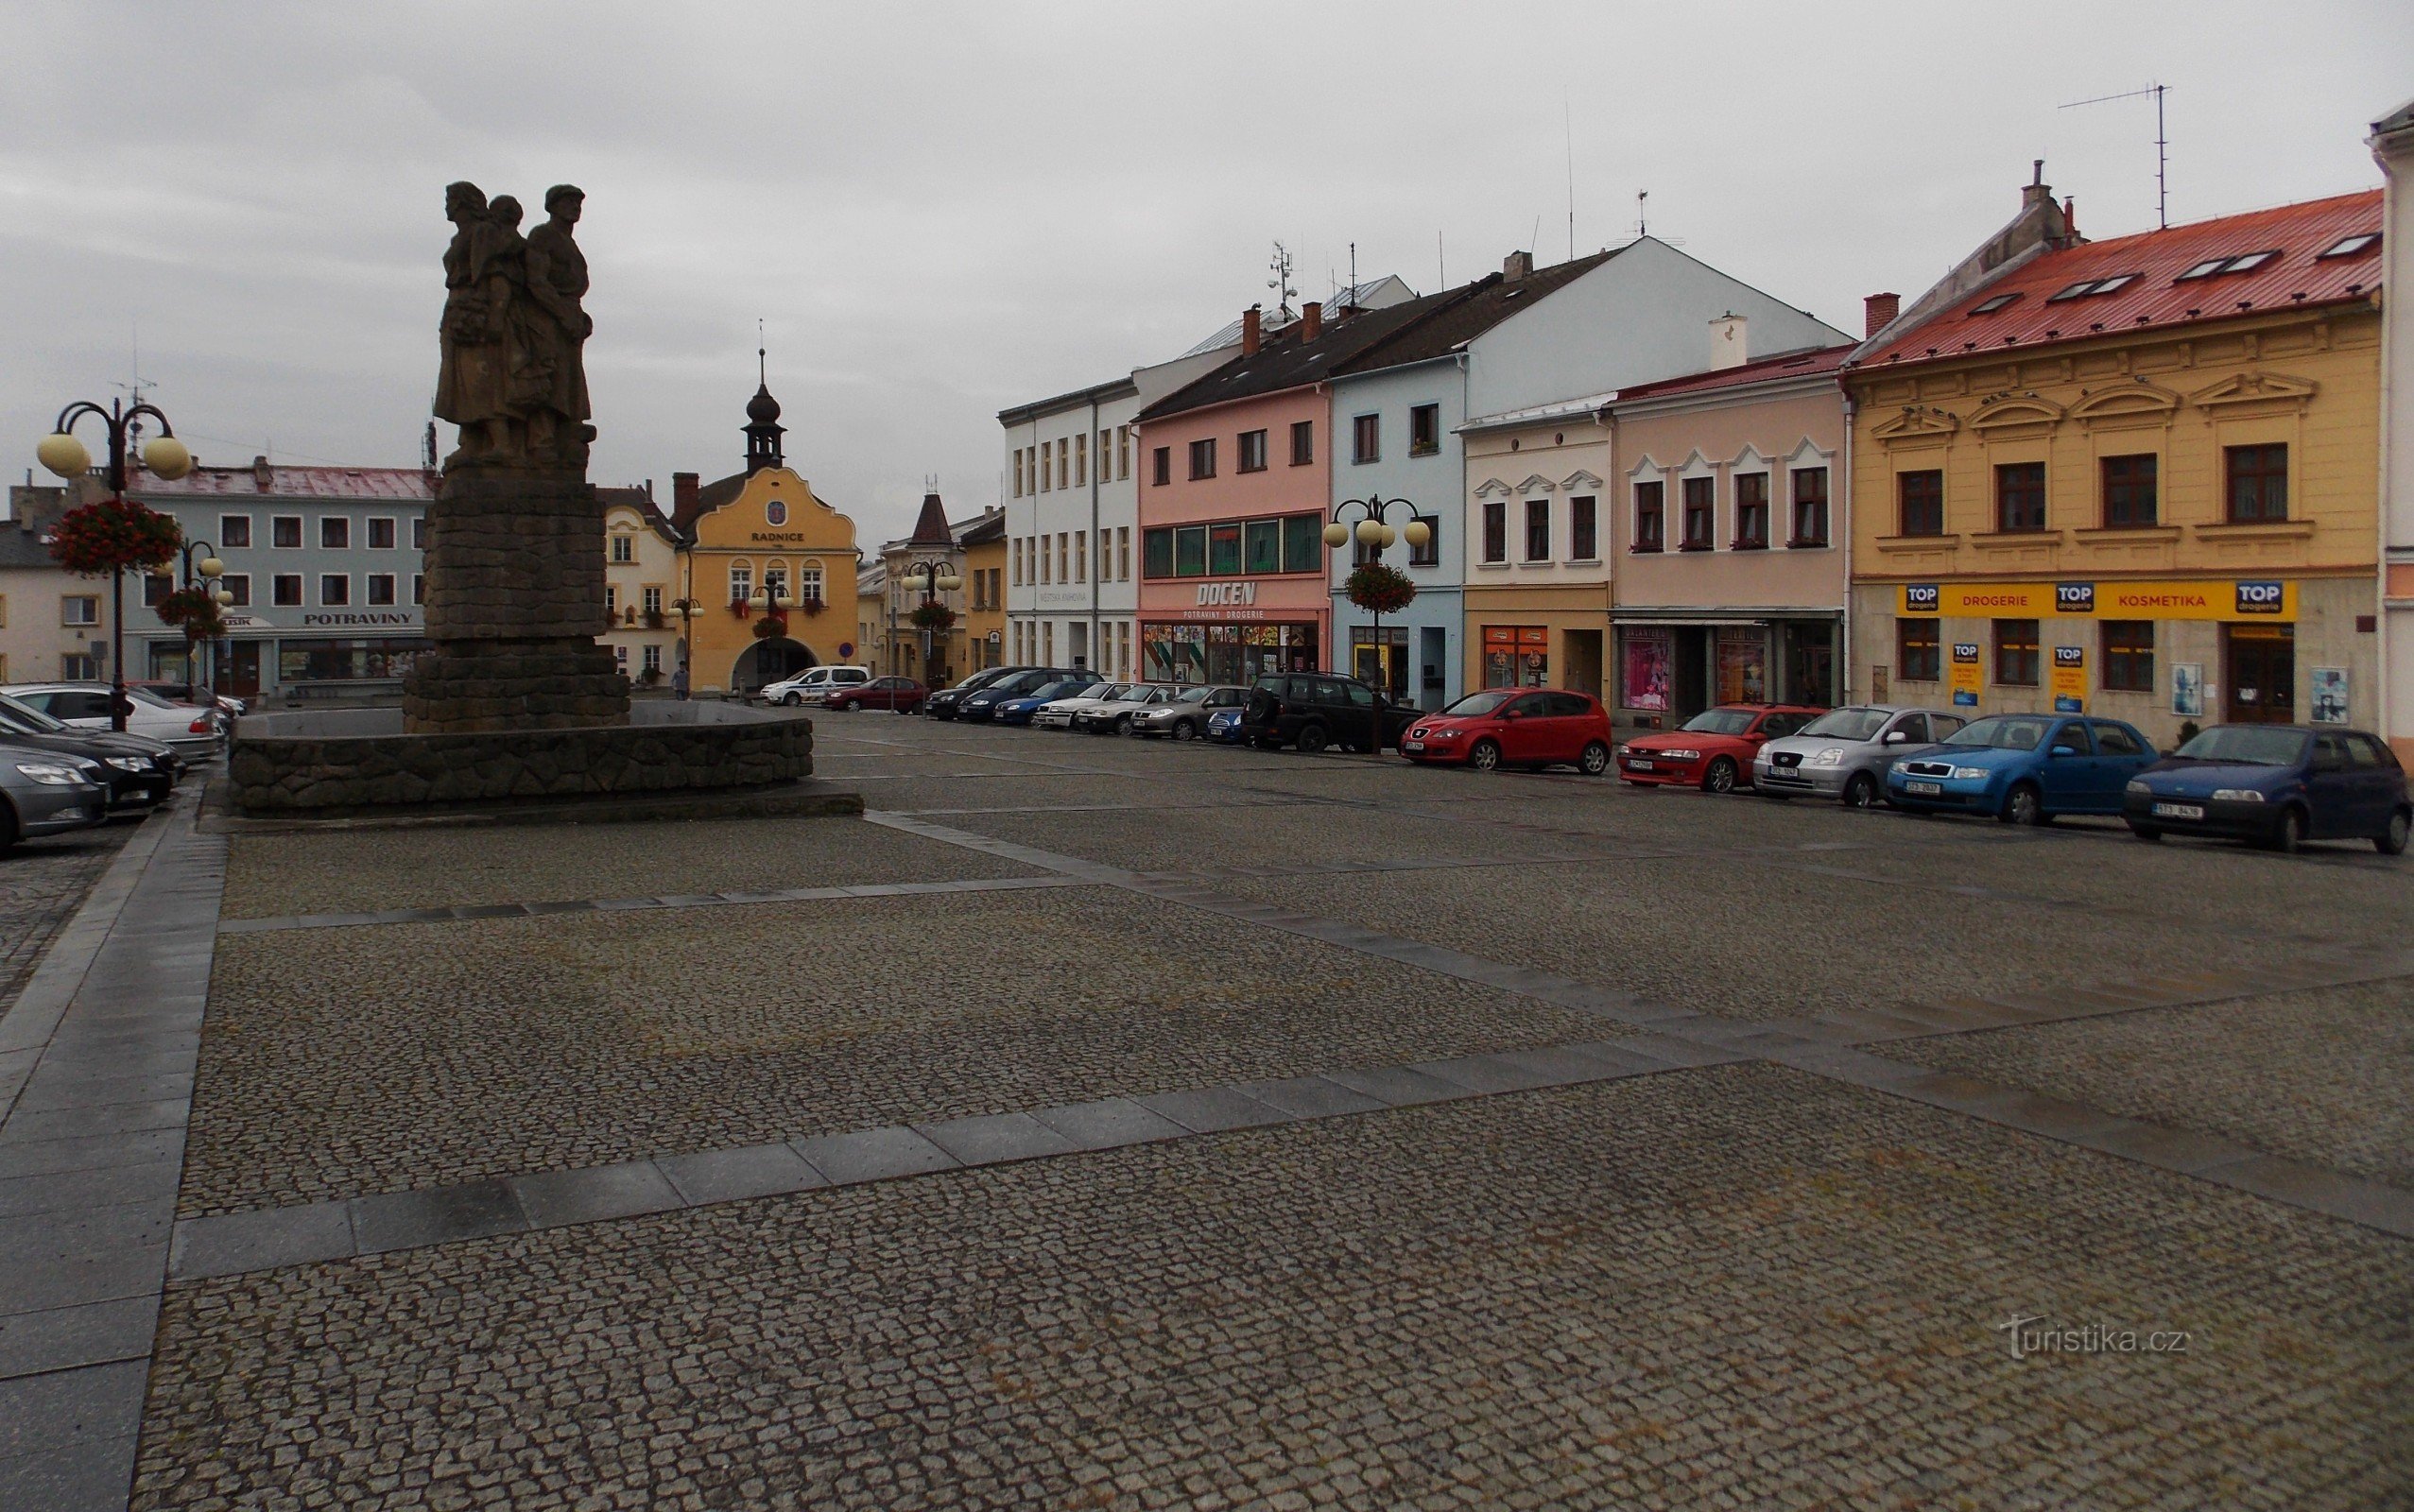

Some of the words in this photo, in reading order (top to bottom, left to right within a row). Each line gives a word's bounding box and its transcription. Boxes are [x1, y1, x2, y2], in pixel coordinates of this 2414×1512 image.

[751, 533, 804, 541] RADNICE
[1196, 582, 1256, 606] DOCEN
[1908, 588, 1937, 601] TOP
[2058, 587, 2092, 601] TOP
[2238, 586, 2281, 601] TOP
[1963, 595, 2027, 607] DROGERIE
[2058, 602, 2092, 610] drogerie
[2118, 595, 2206, 607] KOSMETIKA
[2238, 603, 2279, 611] drogerie
[303, 613, 412, 625] POTRAVINY
[1183, 610, 1220, 619] POTRAVINY
[1227, 610, 1264, 619] DROGERIE
[1955, 645, 1977, 656] TOP
[2056, 648, 2081, 660] TOP
